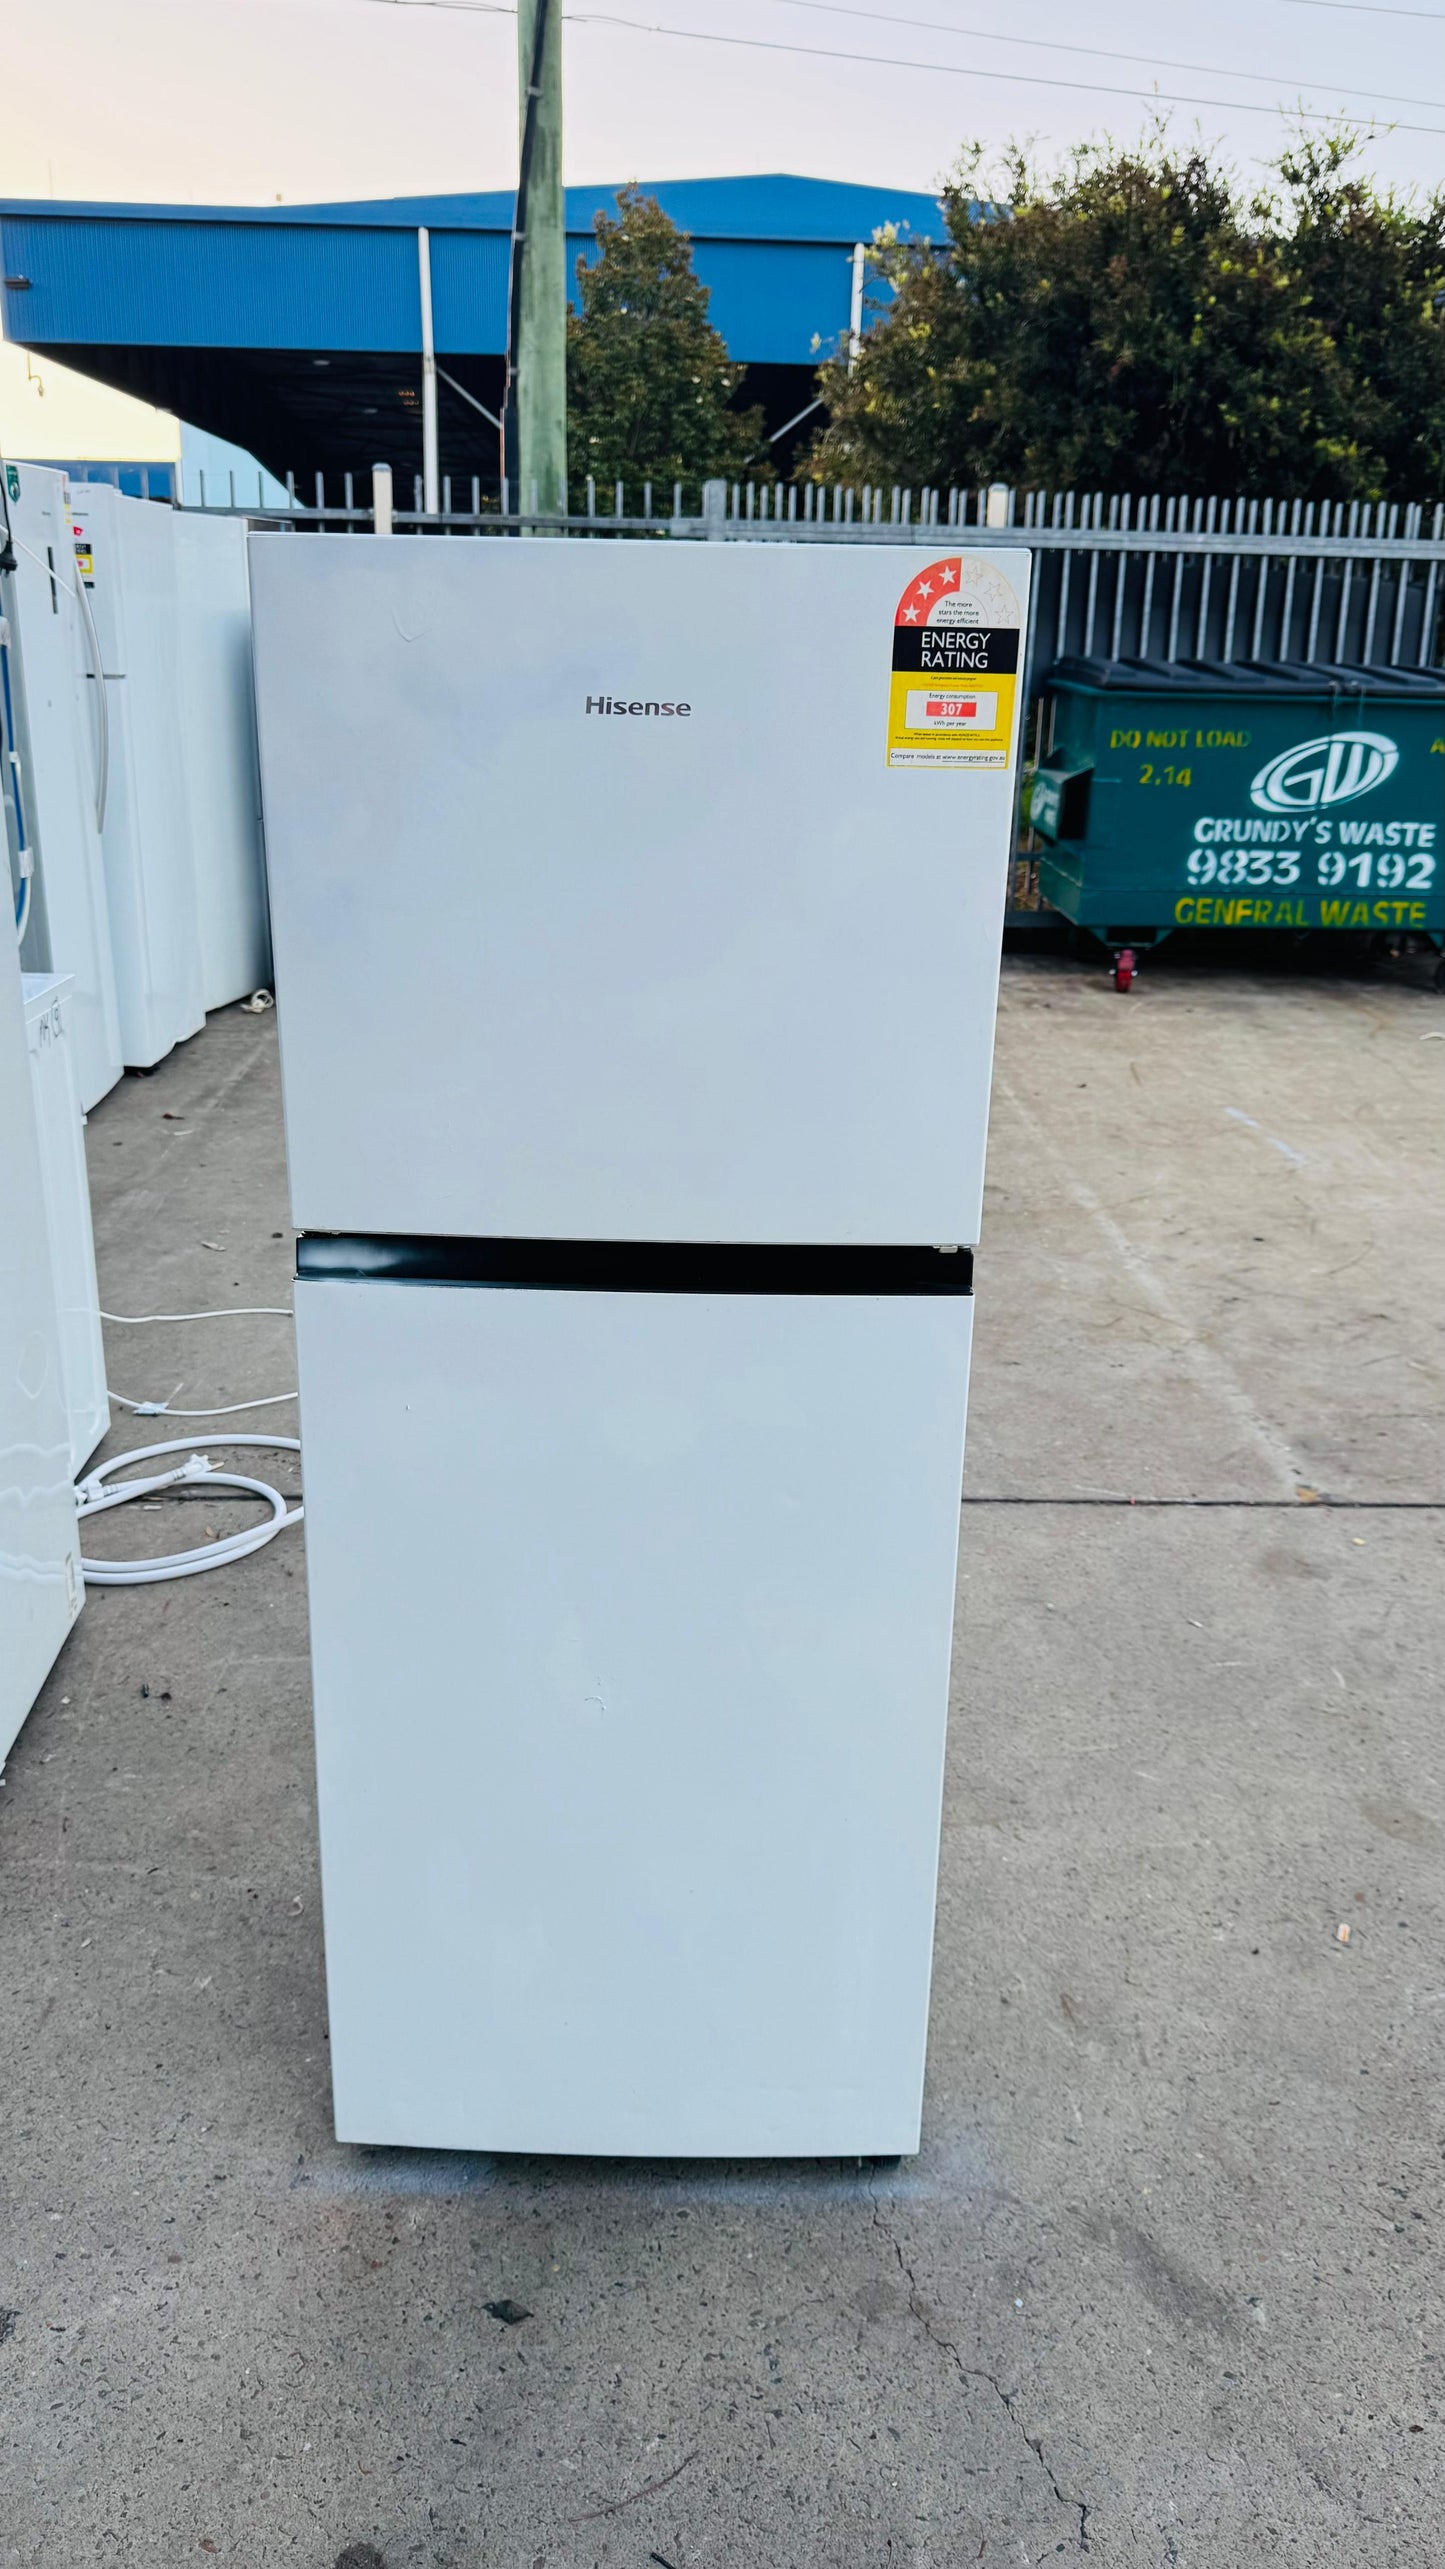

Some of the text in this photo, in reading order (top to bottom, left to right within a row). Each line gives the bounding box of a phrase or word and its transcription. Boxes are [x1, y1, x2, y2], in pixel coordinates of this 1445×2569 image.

[956, 617, 979, 625] efficient
[921, 631, 991, 650] ENERGY
[921, 650, 988, 669] RATING
[929, 692, 945, 700] Energy
[586, 696, 692, 717] Hisense
[940, 703, 963, 716] 307
[1110, 729, 1252, 749] DO NOT LOAD
[890, 752, 915, 761] Compare
[1139, 763, 1192, 787] 2.14
[1194, 815, 1437, 848] GRUNDY'S WASTE
[1187, 848, 1437, 890] 9833 9192
[1320, 900, 1427, 929] WASTE
